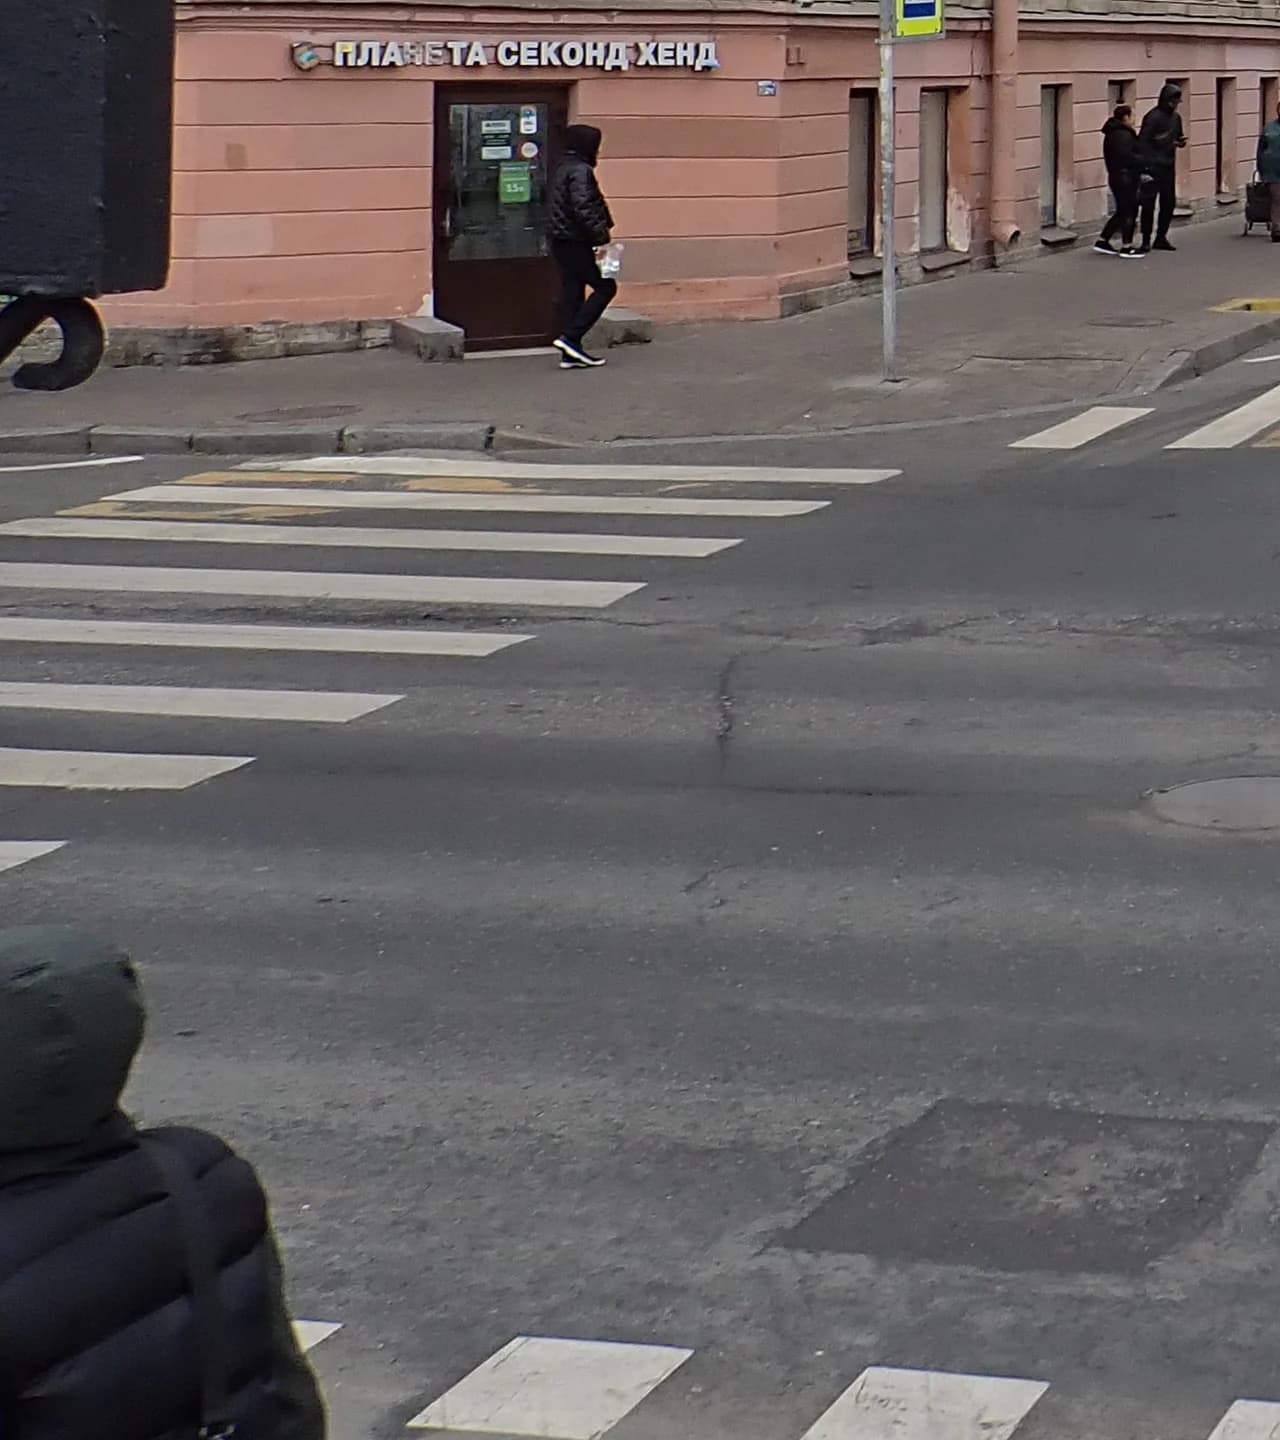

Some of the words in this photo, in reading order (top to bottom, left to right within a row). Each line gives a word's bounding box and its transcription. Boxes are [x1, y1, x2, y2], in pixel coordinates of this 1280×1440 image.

[334, 41, 488, 66] ПЛАНЕТА
[497, 41, 629, 71] СЕКОНД
[636, 41, 720, 71] ХЕНД
